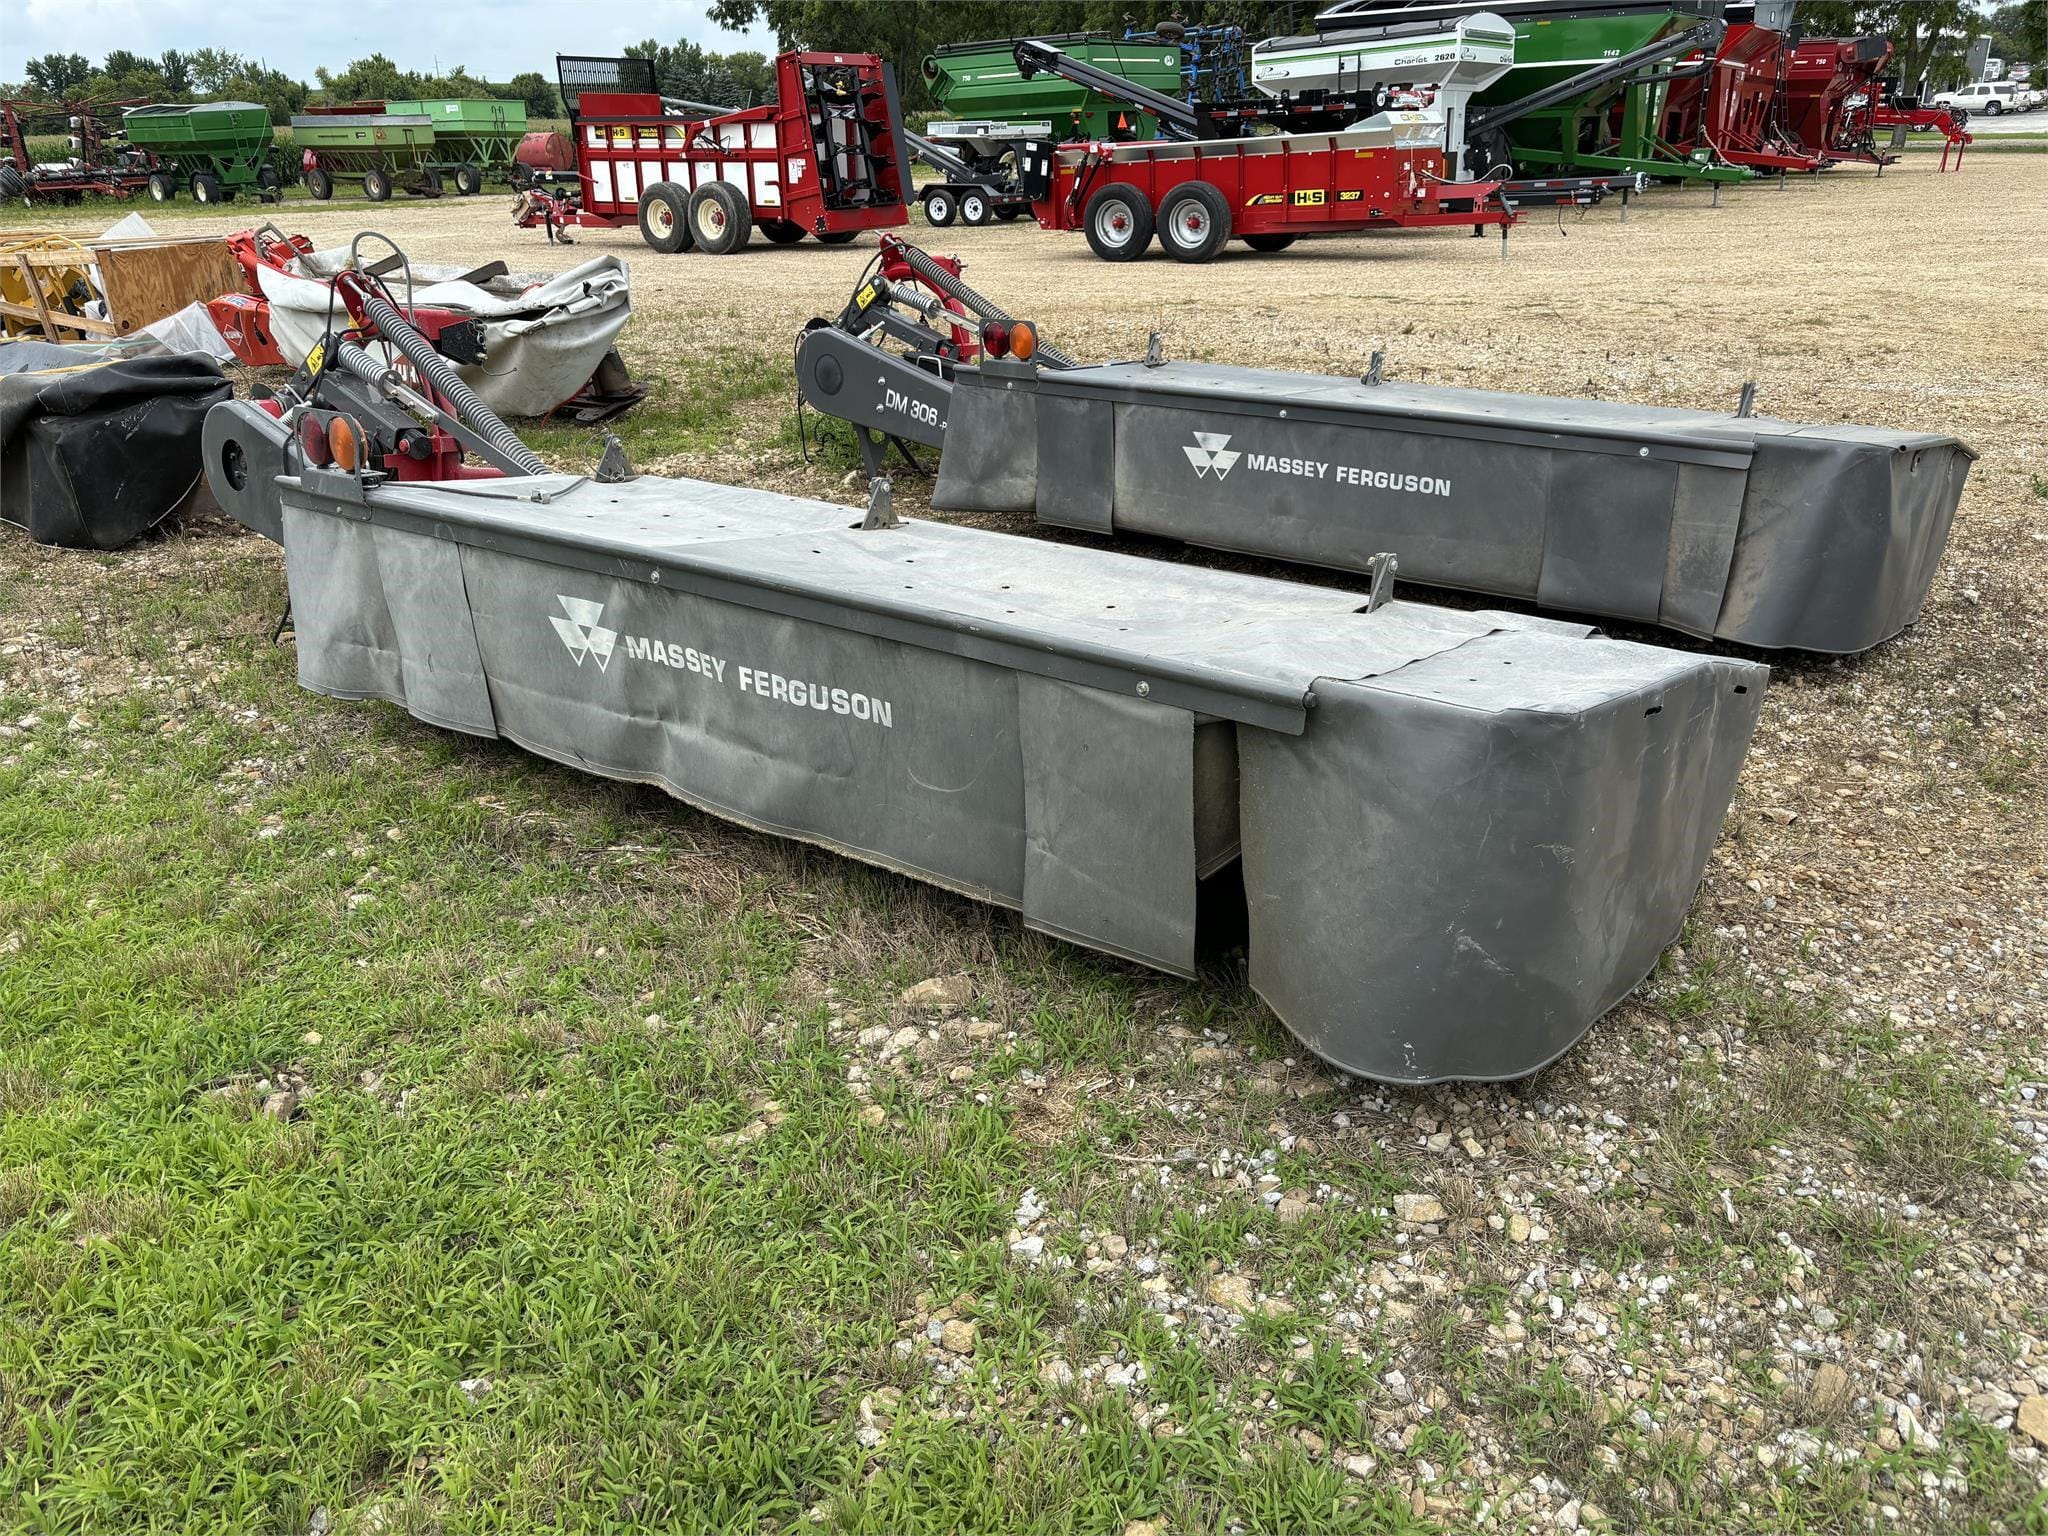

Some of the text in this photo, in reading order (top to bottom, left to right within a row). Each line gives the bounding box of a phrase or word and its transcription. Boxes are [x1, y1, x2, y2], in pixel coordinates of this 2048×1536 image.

[1394, 55, 1428, 65] Chariot
[1339, 191, 1361, 201] 3237
[885, 388, 909, 415] DM
[910, 400, 938, 427] 306
[1247, 453, 1452, 497] MASSEY FERGUSON
[625, 634, 894, 729] MASSEY FERGUSON
